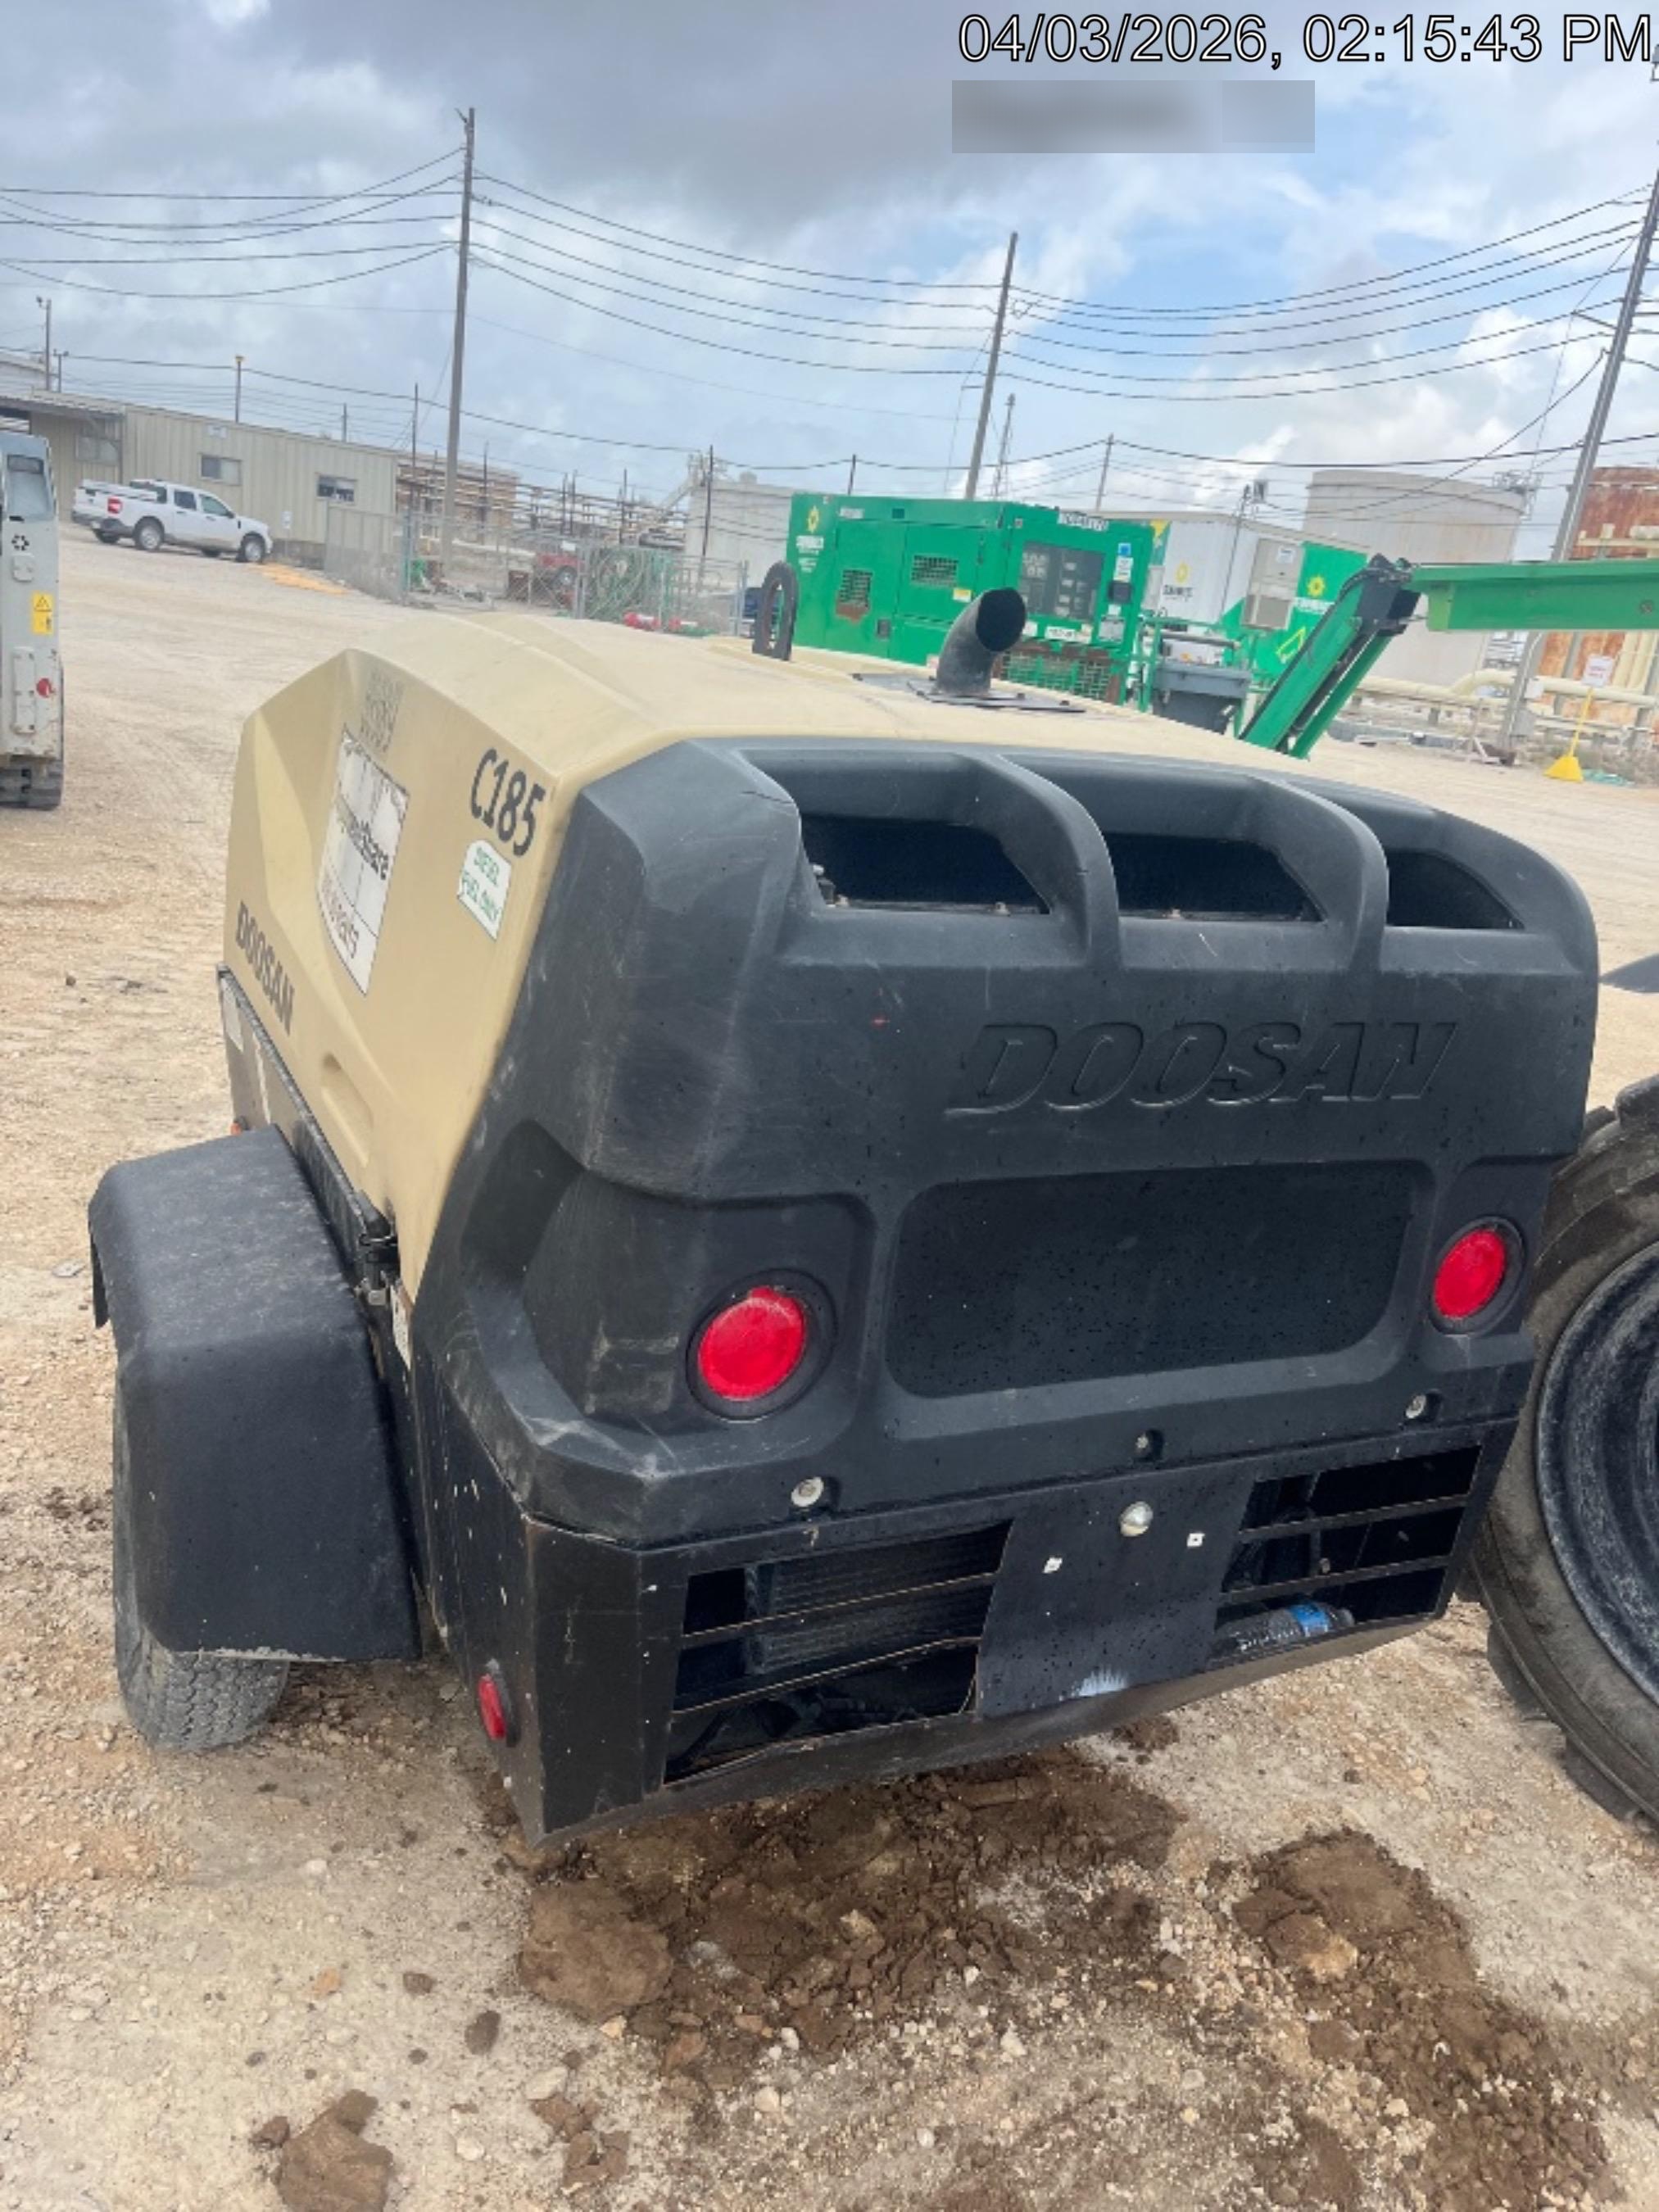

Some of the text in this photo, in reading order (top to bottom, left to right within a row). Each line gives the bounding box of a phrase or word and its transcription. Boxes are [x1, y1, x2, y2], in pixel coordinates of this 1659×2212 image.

[471, 749, 546, 857] C185
[236, 900, 295, 1036] DOOSAN
[943, 1021, 1457, 1115] DOOSAN
